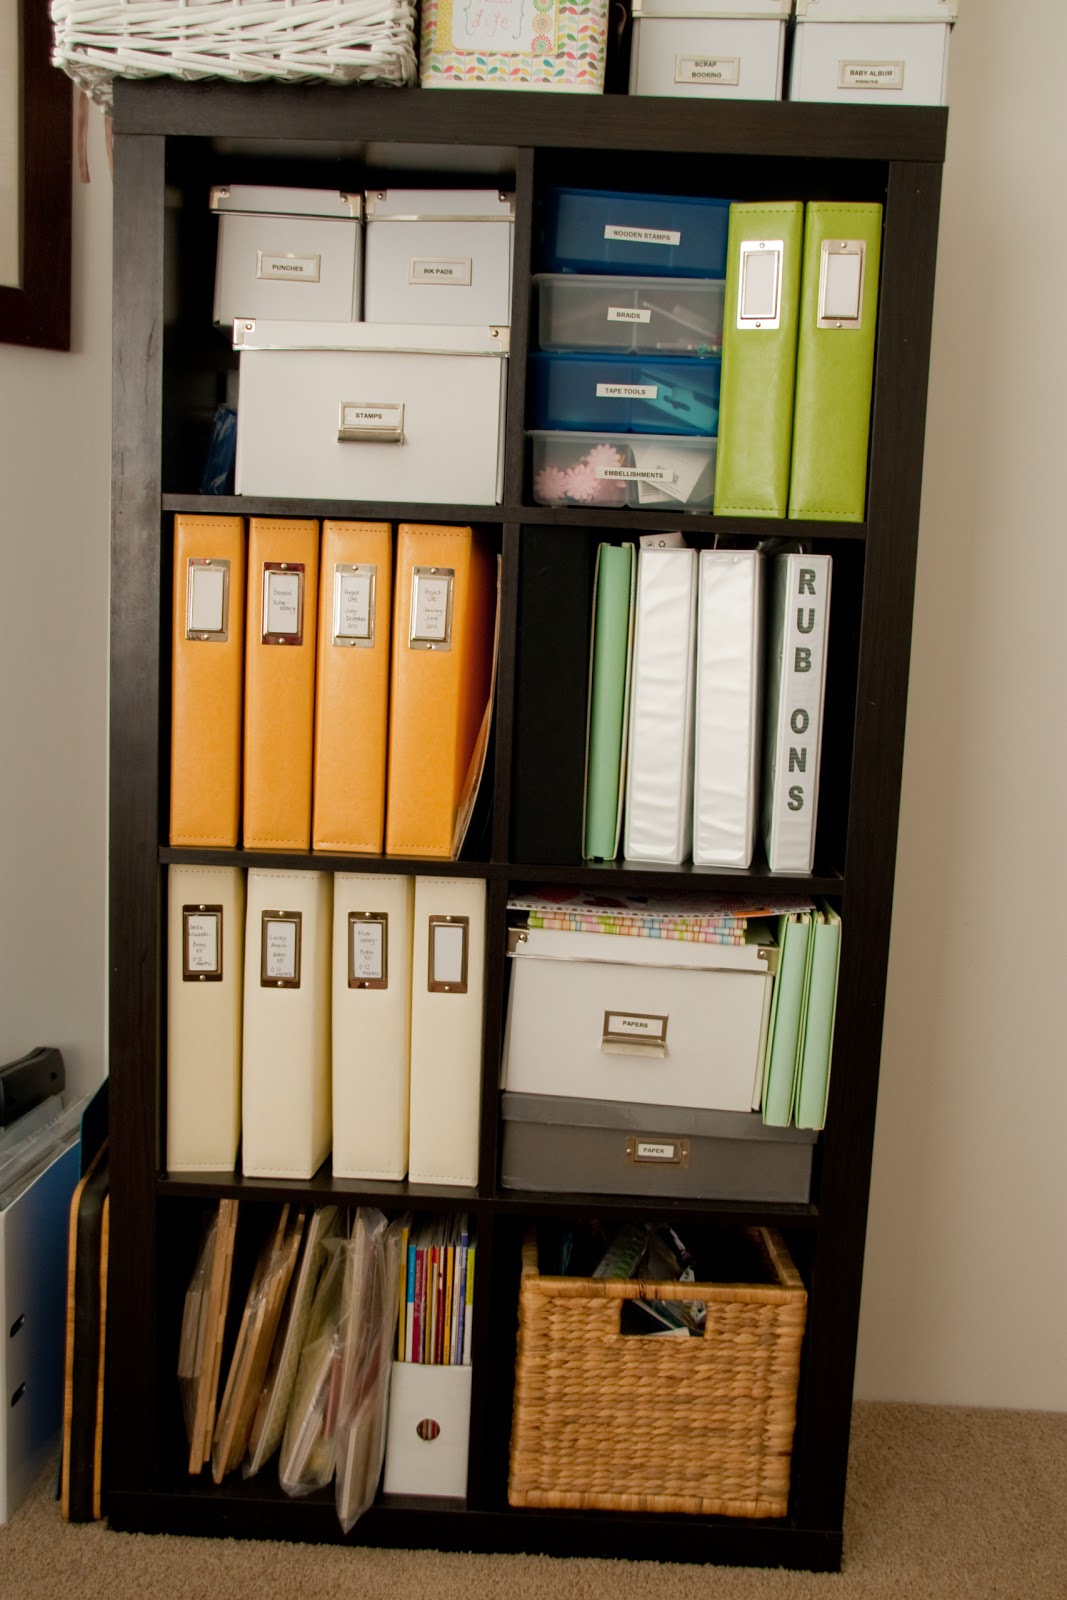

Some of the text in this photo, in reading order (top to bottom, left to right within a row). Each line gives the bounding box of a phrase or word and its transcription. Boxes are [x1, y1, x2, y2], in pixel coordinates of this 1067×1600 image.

[849, 69, 868, 77] BABY
[613, 229, 671, 241] WOODEN STAMPS
[272, 264, 304, 272] PUNCHES
[616, 311, 641, 319] BRAIDS
[355, 412, 383, 420] STAMPS
[604, 469, 664, 479] EMBELLISHMENTS
[622, 1020, 648, 1028] PAPERS
